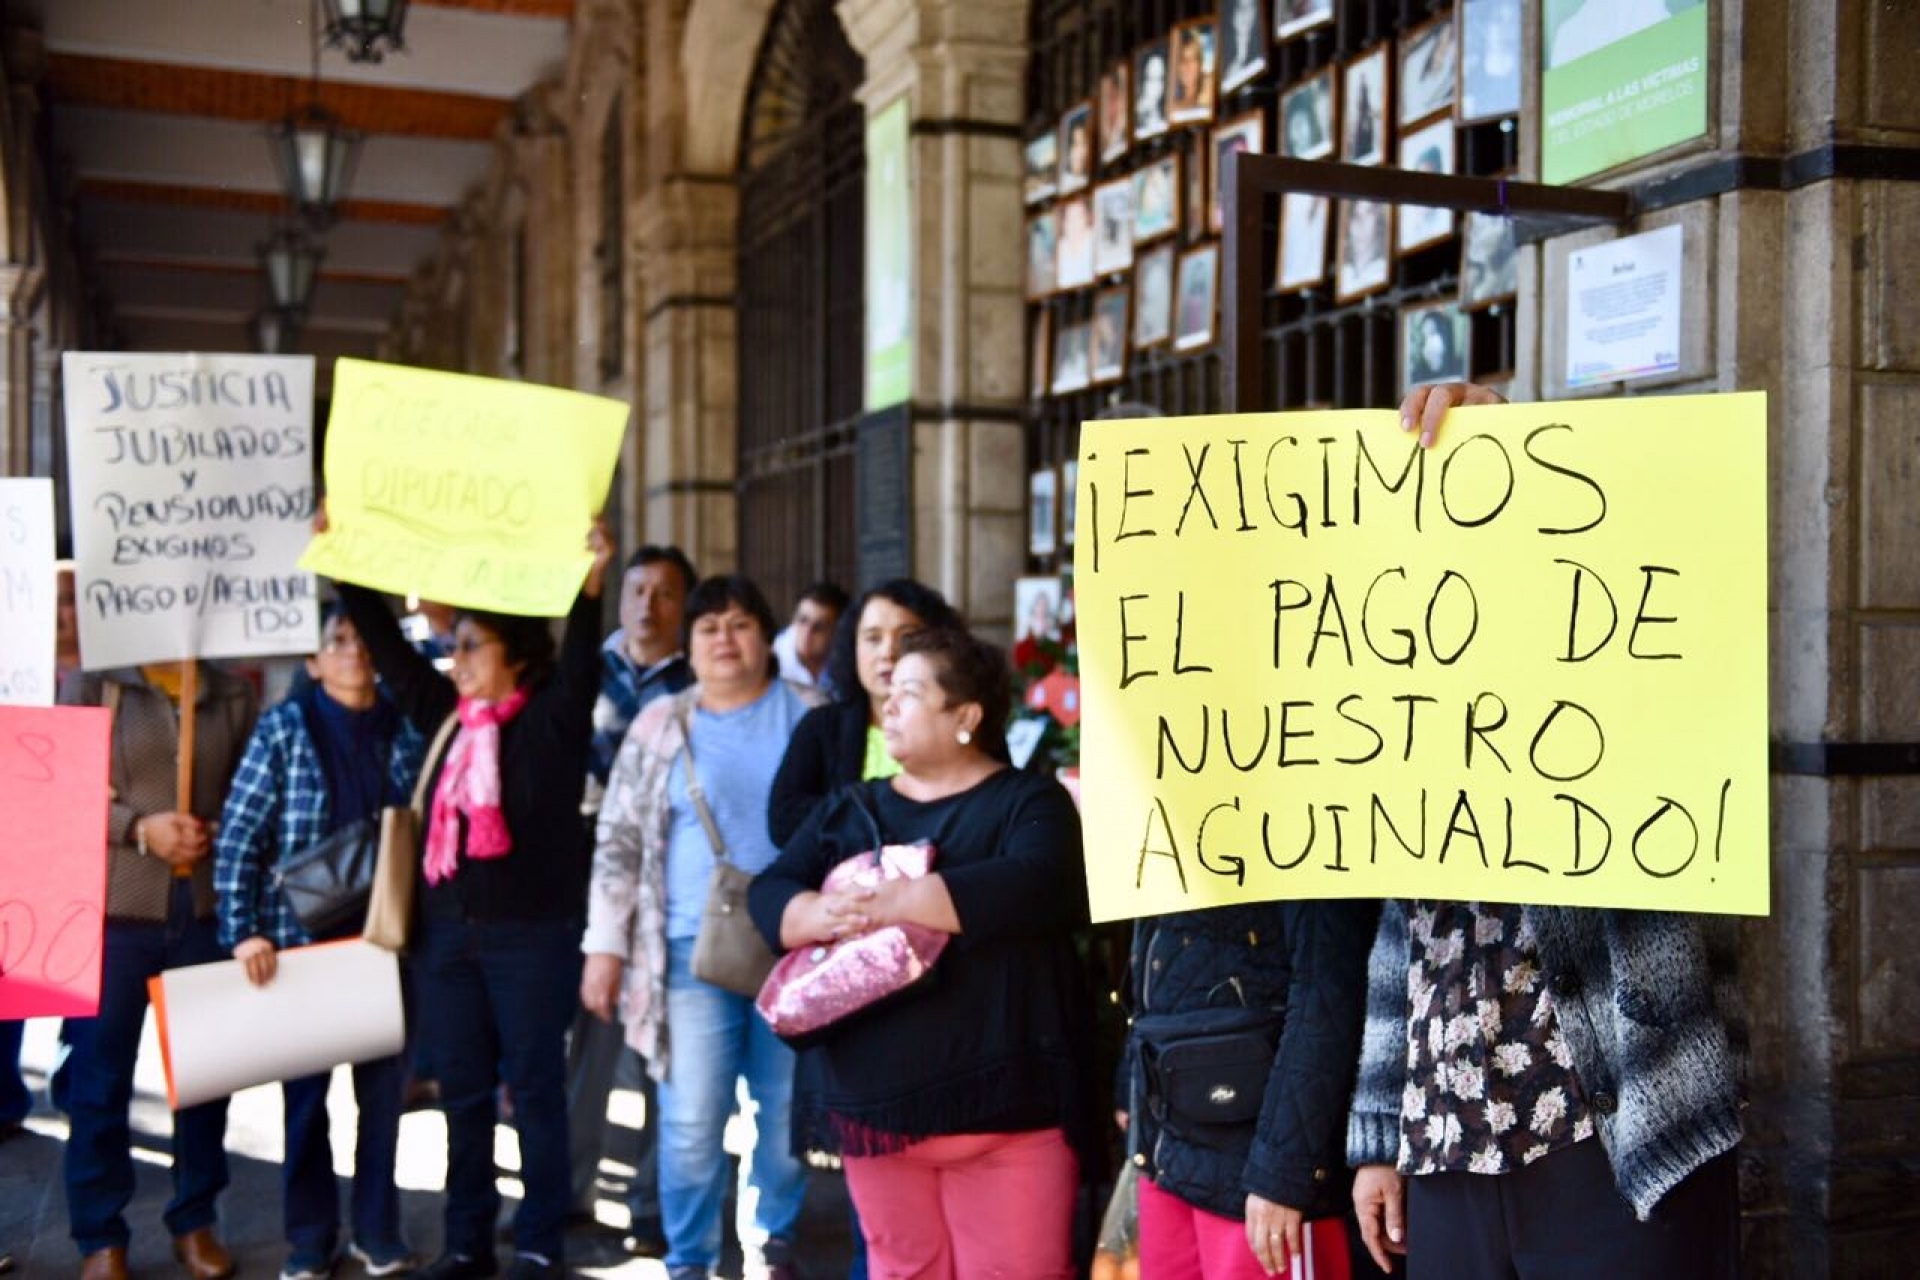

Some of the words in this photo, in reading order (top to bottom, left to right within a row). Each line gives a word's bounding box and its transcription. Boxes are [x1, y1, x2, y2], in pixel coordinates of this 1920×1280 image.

[89, 363, 293, 412] JUSTICIA
[94, 422, 306, 466] JUBILADOS
[361, 455, 535, 527] DIPUTADO
[86, 579, 177, 619] PAGO
[1118, 590, 1213, 690] EL
[1268, 565, 1479, 669] PAGO
[1552, 557, 1683, 663] DE
[1156, 691, 1605, 782] NUESTRO
[1136, 778, 1732, 894] AGUINALDO!
